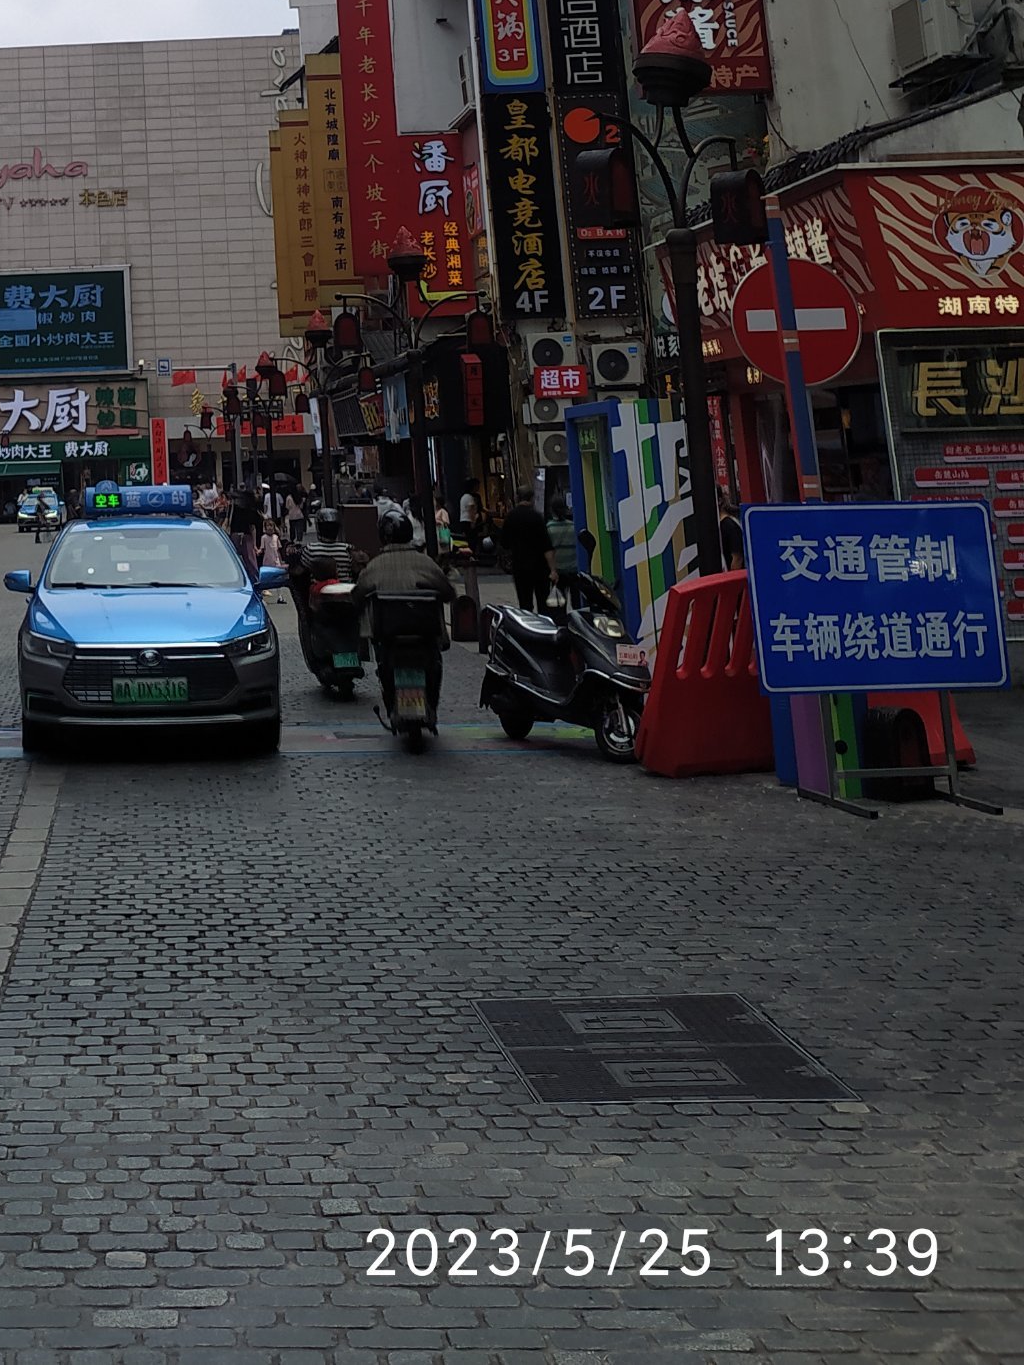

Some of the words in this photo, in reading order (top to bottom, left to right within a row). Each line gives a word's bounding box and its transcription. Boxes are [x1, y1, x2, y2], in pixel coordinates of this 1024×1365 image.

[722, 2, 738, 48] SAUCE
[497, 48, 526, 62] 3F
[412, 140, 455, 216] 潘厨
[500, 99, 547, 291] 皇都电竞酒店
[420, 230, 438, 279] 老长沙
[443, 221, 463, 286] 经典湘菜
[4, 283, 105, 310] 费大厨
[515, 291, 549, 313] 4F
[587, 285, 626, 311] 2F
[937, 295, 1020, 316] 湖南特
[540, 368, 581, 390] 超市
[64, 440, 110, 458] 费大厨
[95, 493, 120, 508] 空车
[778, 534, 958, 583] 交通管制
[769, 610, 988, 663] 车辆绕道通行
